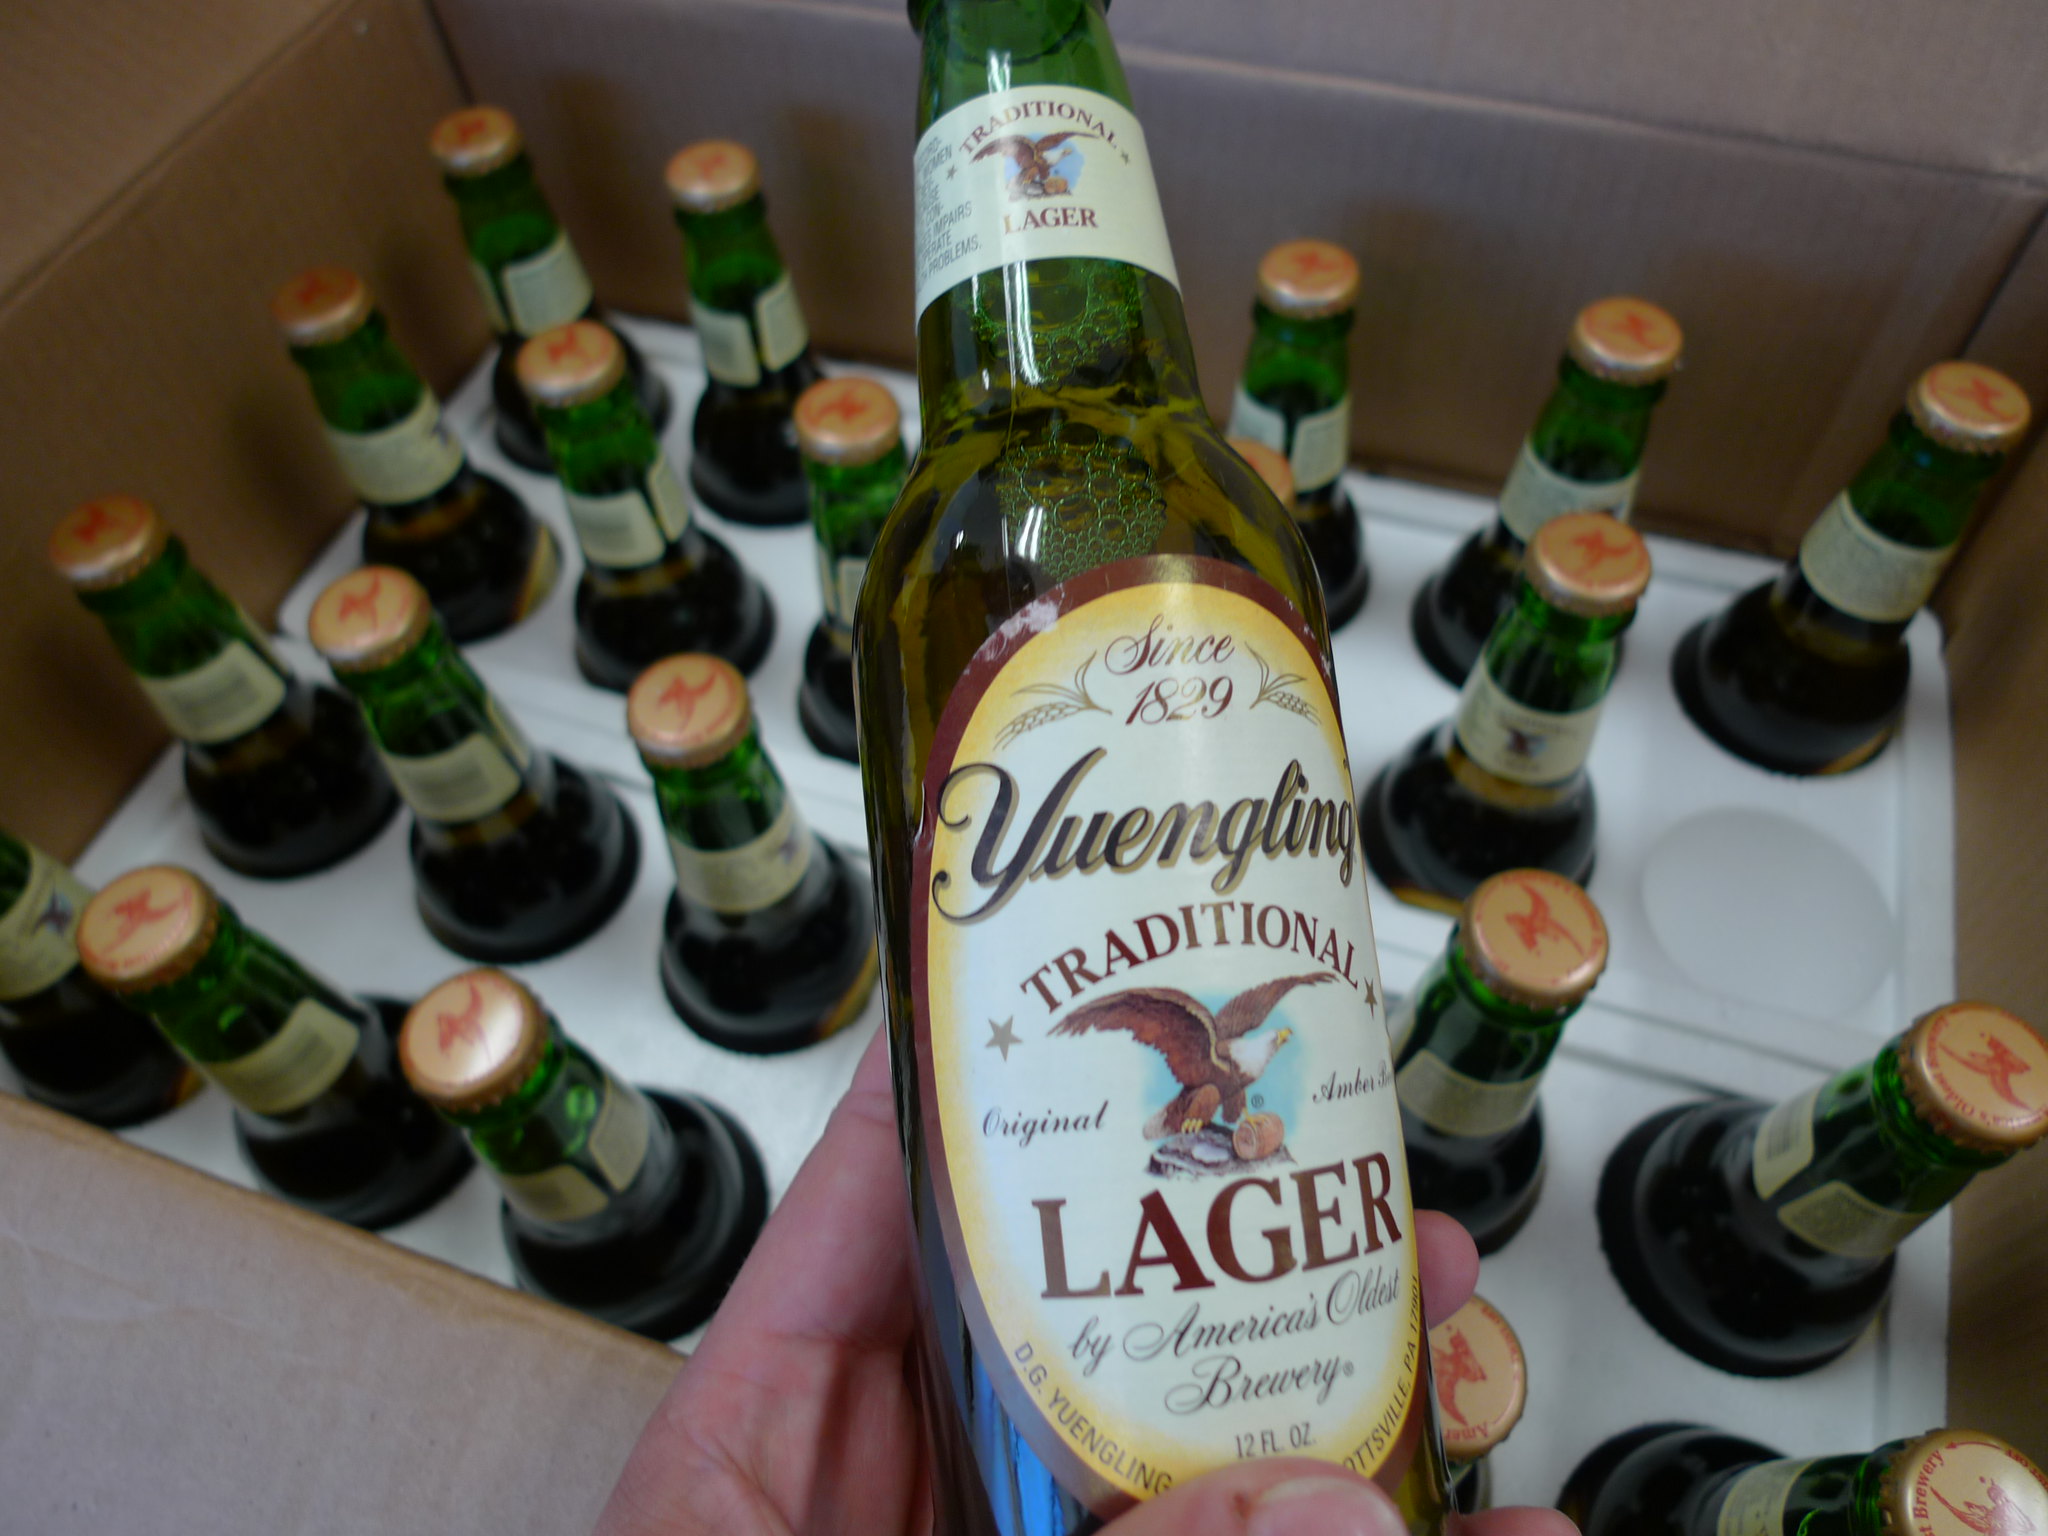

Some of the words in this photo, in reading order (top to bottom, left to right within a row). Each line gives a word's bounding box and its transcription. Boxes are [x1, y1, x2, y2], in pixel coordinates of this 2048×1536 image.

[960, 100, 1117, 155] TRADITIONAL
[933, 200, 973, 234] IMPAIRS
[1004, 206, 1099, 235] LAGER
[1104, 614, 1235, 676] Since
[1126, 675, 1233, 726] 1829
[931, 747, 1357, 924] Yuengling
[1020, 901, 1361, 1014] TRADITIONAL
[983, 1100, 1109, 1148] Original
[1312, 1067, 1375, 1105] Amber
[1032, 1151, 1403, 1300] LAGER
[1069, 1317, 1115, 1377] by
[1123, 1291, 1322, 1362] America's
[1326, 1266, 1400, 1325] Oldest
[1403, 1341, 1418, 1374] PA
[1014, 1340, 1048, 1395] D.G.
[1048, 1387, 1173, 1496] YUENGLING
[1235, 1433, 1257, 1459] 12
[1260, 1429, 1286, 1454] FL.
[1290, 1423, 1319, 1450] OZ.
[1912, 1449, 1946, 1520] Brewery
